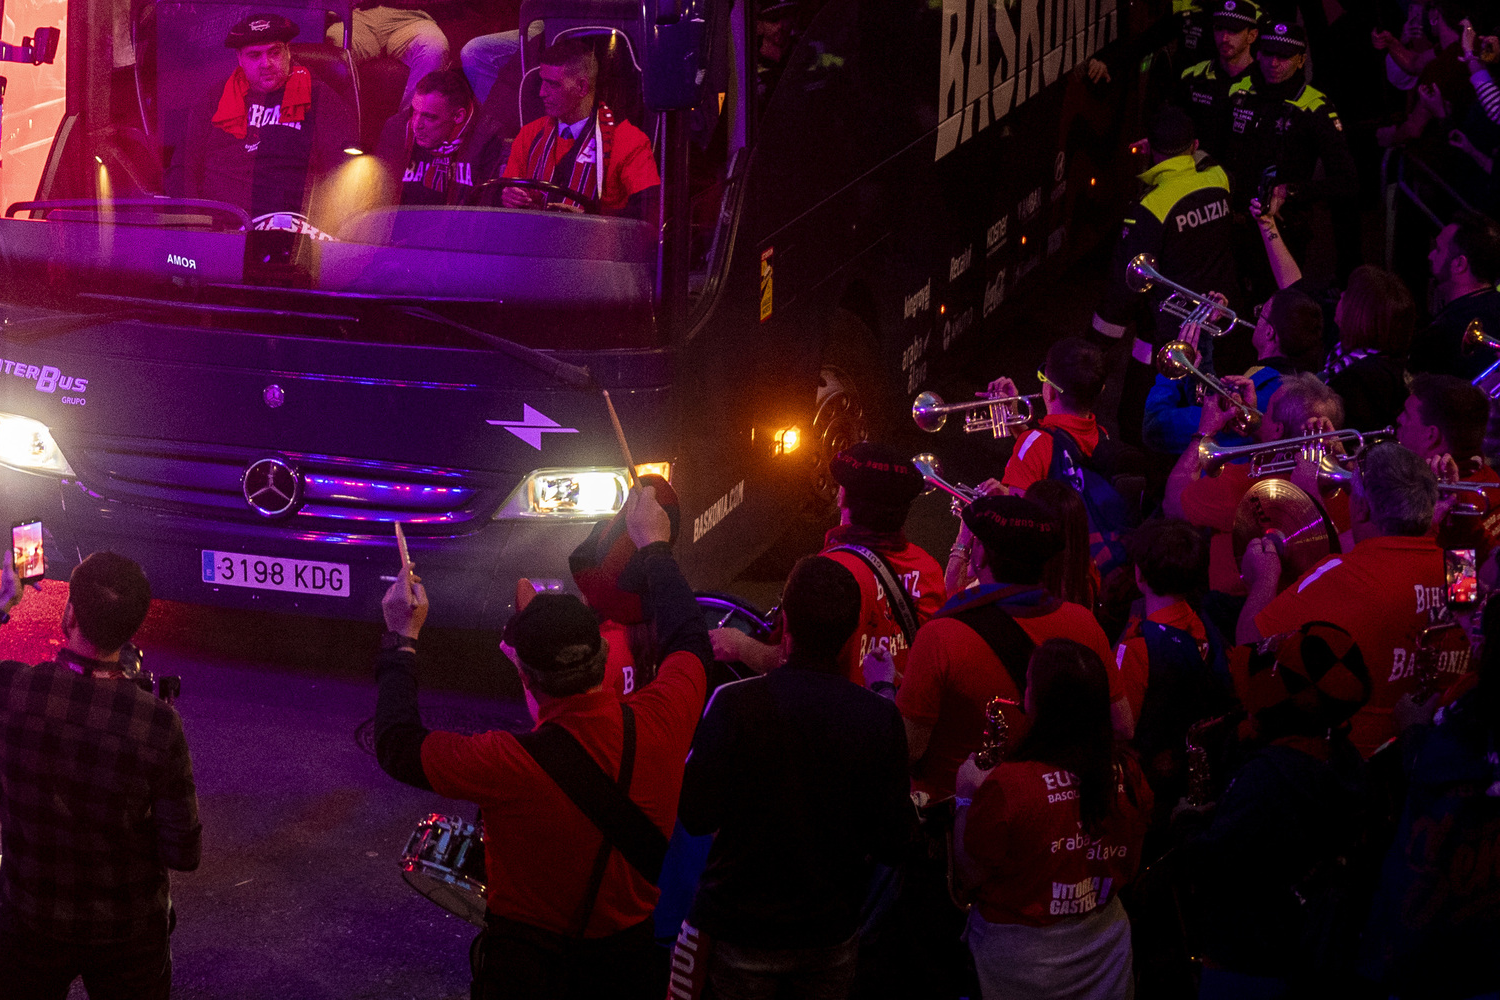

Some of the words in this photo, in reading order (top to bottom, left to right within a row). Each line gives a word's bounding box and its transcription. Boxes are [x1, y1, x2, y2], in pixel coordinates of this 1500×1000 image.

[1175, 199, 1231, 233] POLIZIA
[61, 396, 86, 406] GRUPO
[693, 480, 744, 543] BASKONIA.COM
[206, 568, 212, 577] E
[221, 557, 284, 585] 3198
[294, 564, 343, 591] KDG
